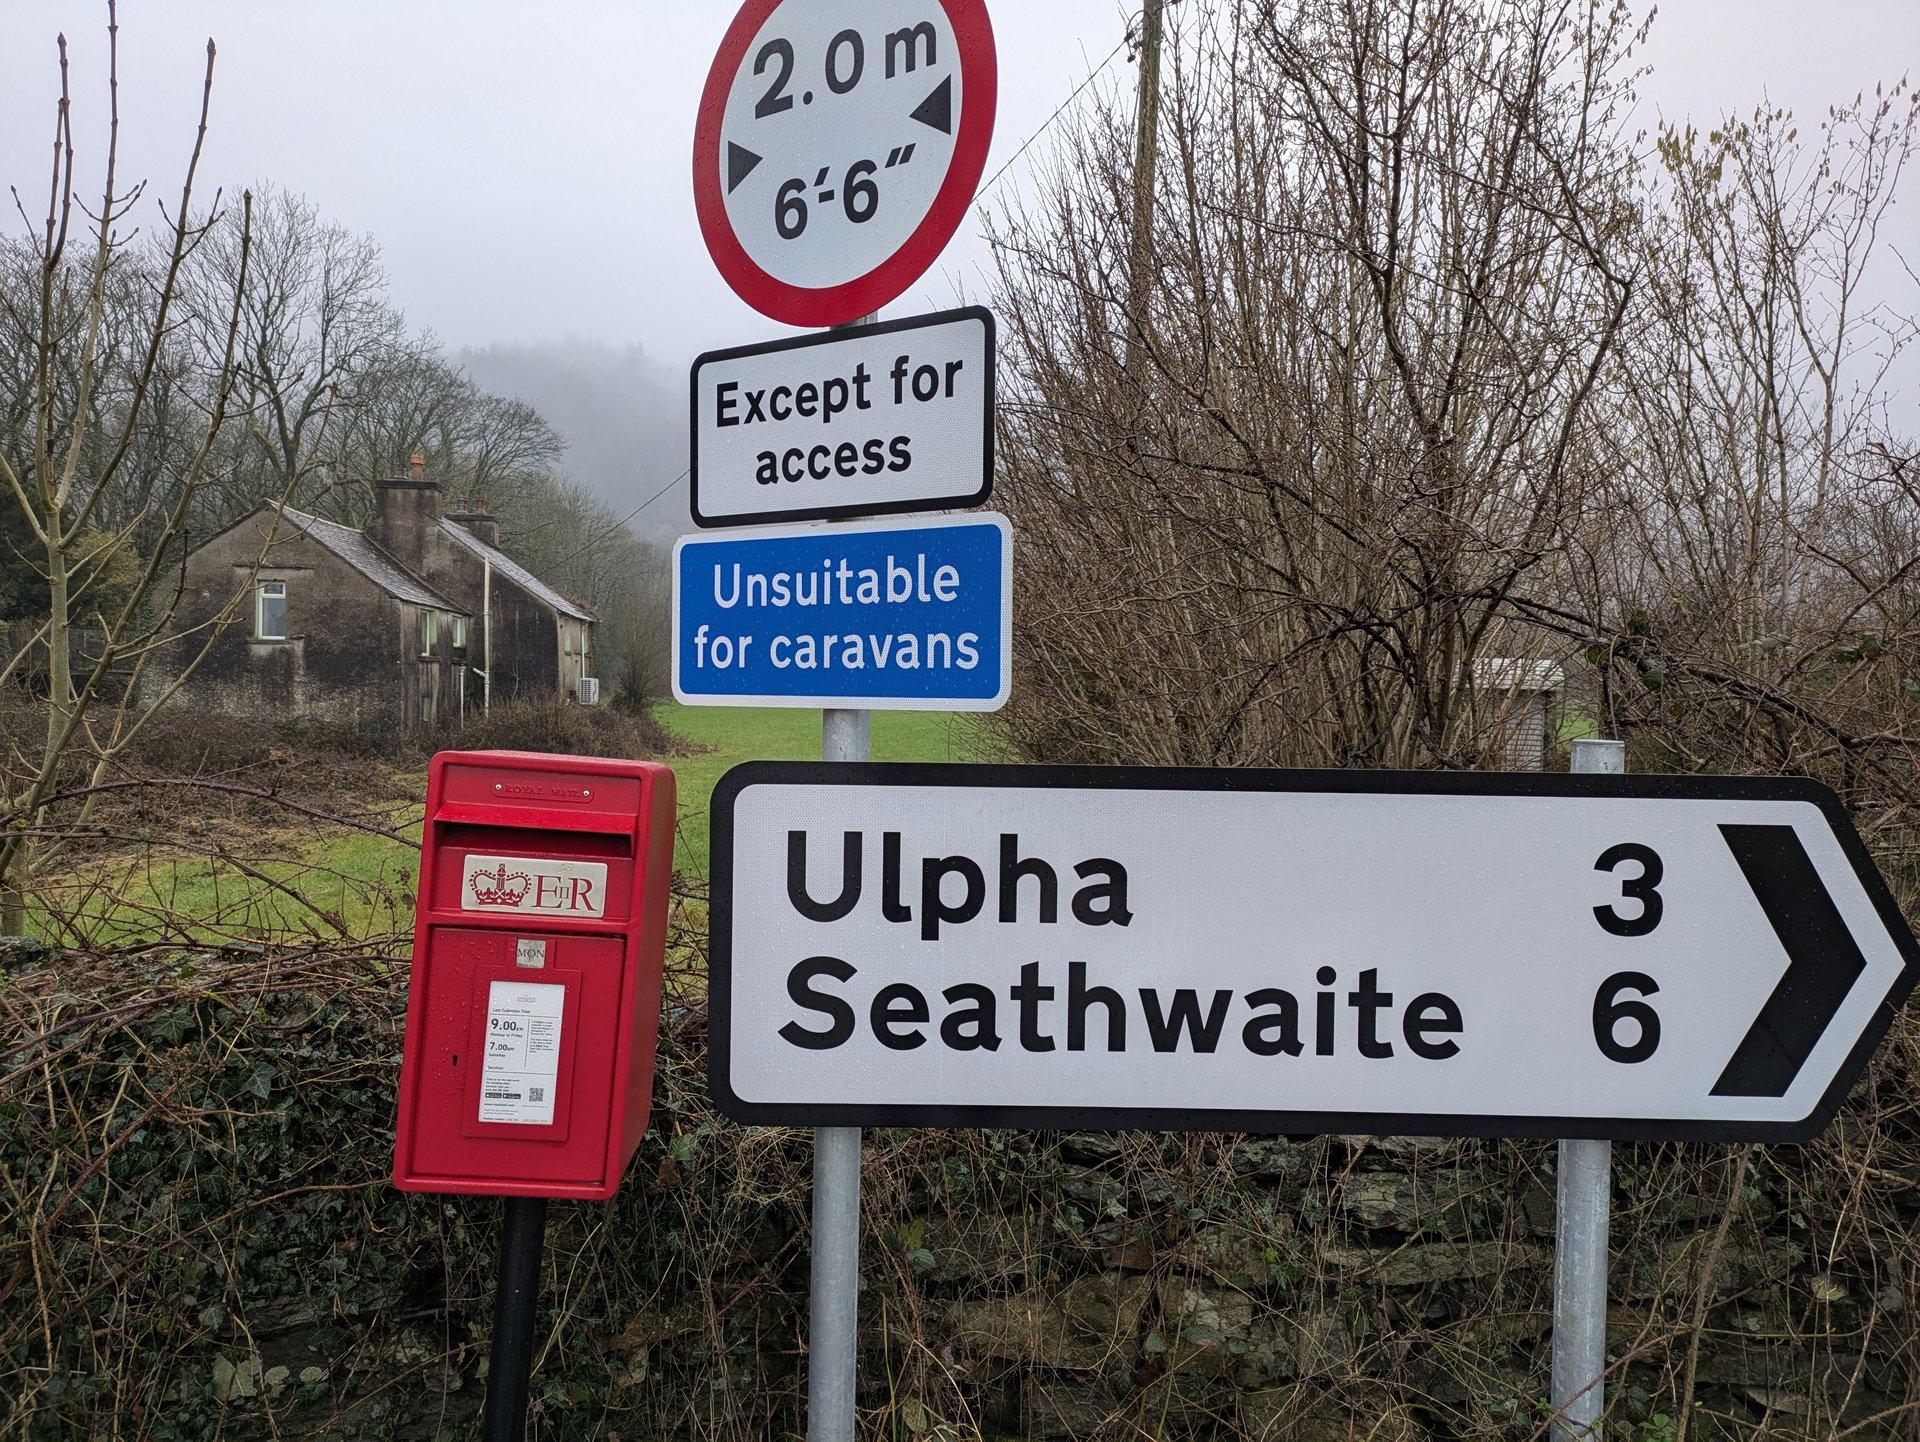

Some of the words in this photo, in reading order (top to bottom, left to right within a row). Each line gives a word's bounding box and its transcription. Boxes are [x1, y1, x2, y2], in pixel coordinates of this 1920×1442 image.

[754, 29, 864, 119] 2.0
[886, 22, 936, 79] m
[717, 362, 871, 427] Except
[891, 356, 963, 405] for
[756, 436, 911, 485] access
[714, 554, 960, 609] Unsuitable
[695, 625, 752, 668] for
[771, 632, 979, 670] caravans
[505, 784, 543, 795] ROYAL
[551, 787, 580, 797] MAIL
[787, 831, 1133, 942] Ulpha
[1593, 843, 1663, 938] 3
[517, 949, 545, 958] MON
[778, 956, 1464, 1060] Seathwaite
[1593, 971, 1661, 1065] 6
